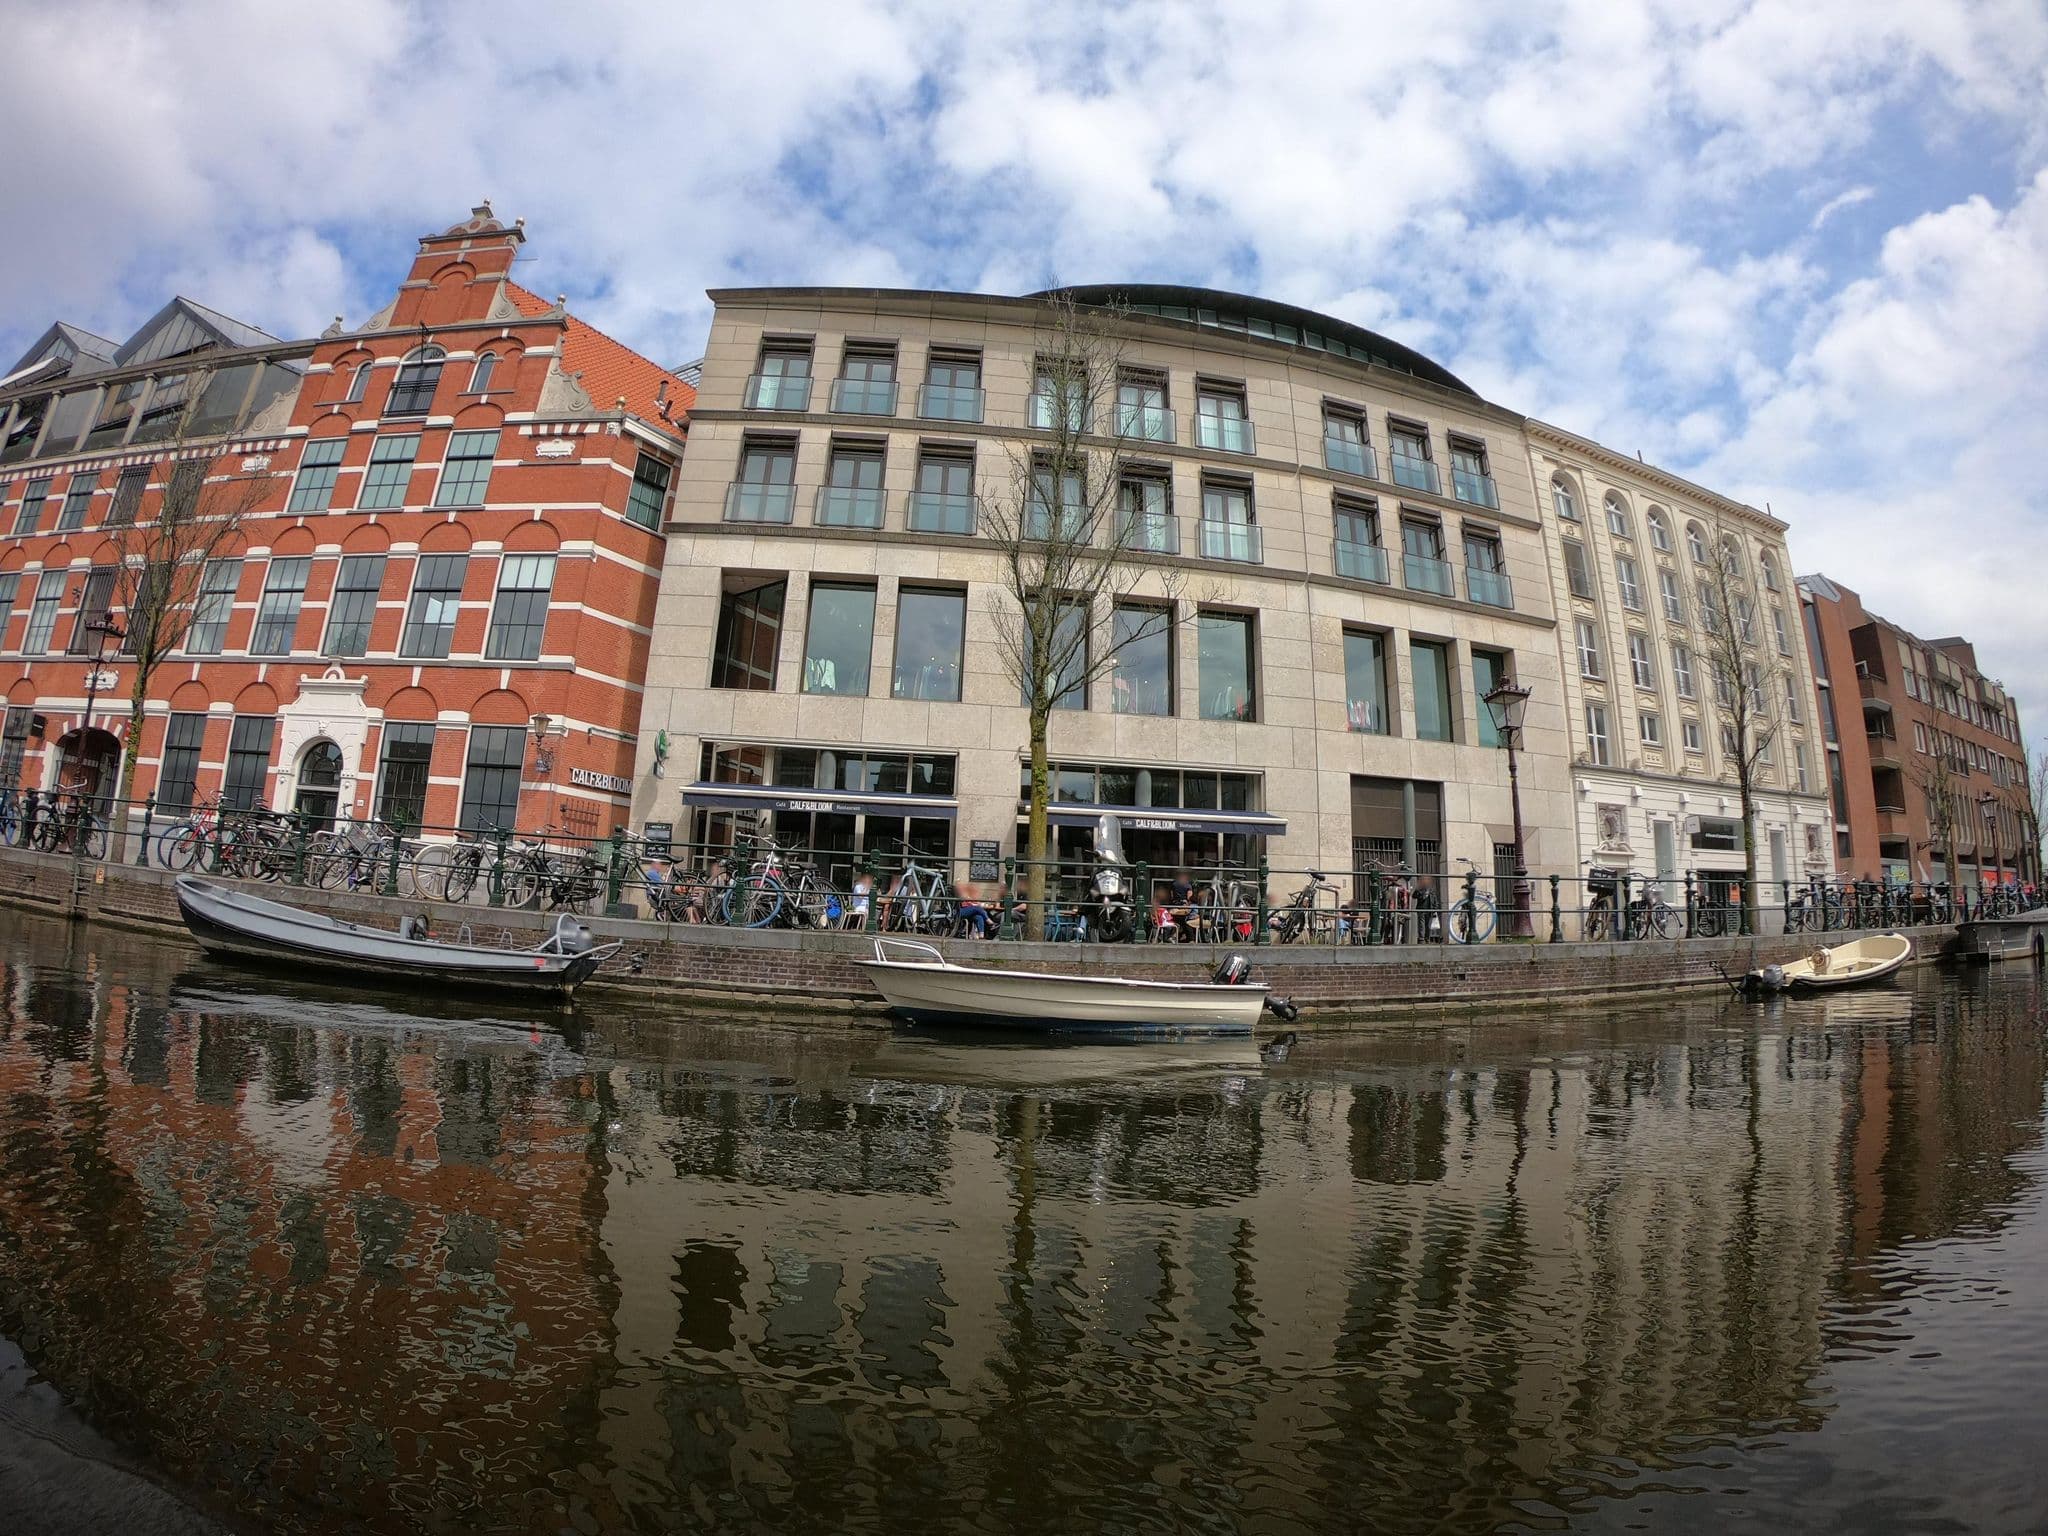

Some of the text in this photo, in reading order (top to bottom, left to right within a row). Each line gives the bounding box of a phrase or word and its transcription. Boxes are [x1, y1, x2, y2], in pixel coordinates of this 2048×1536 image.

[572, 767, 633, 793] CALF&BLOOM
[789, 800, 833, 812] CALF&BLOOM
[1135, 819, 1176, 829] CALF&BLOOM
